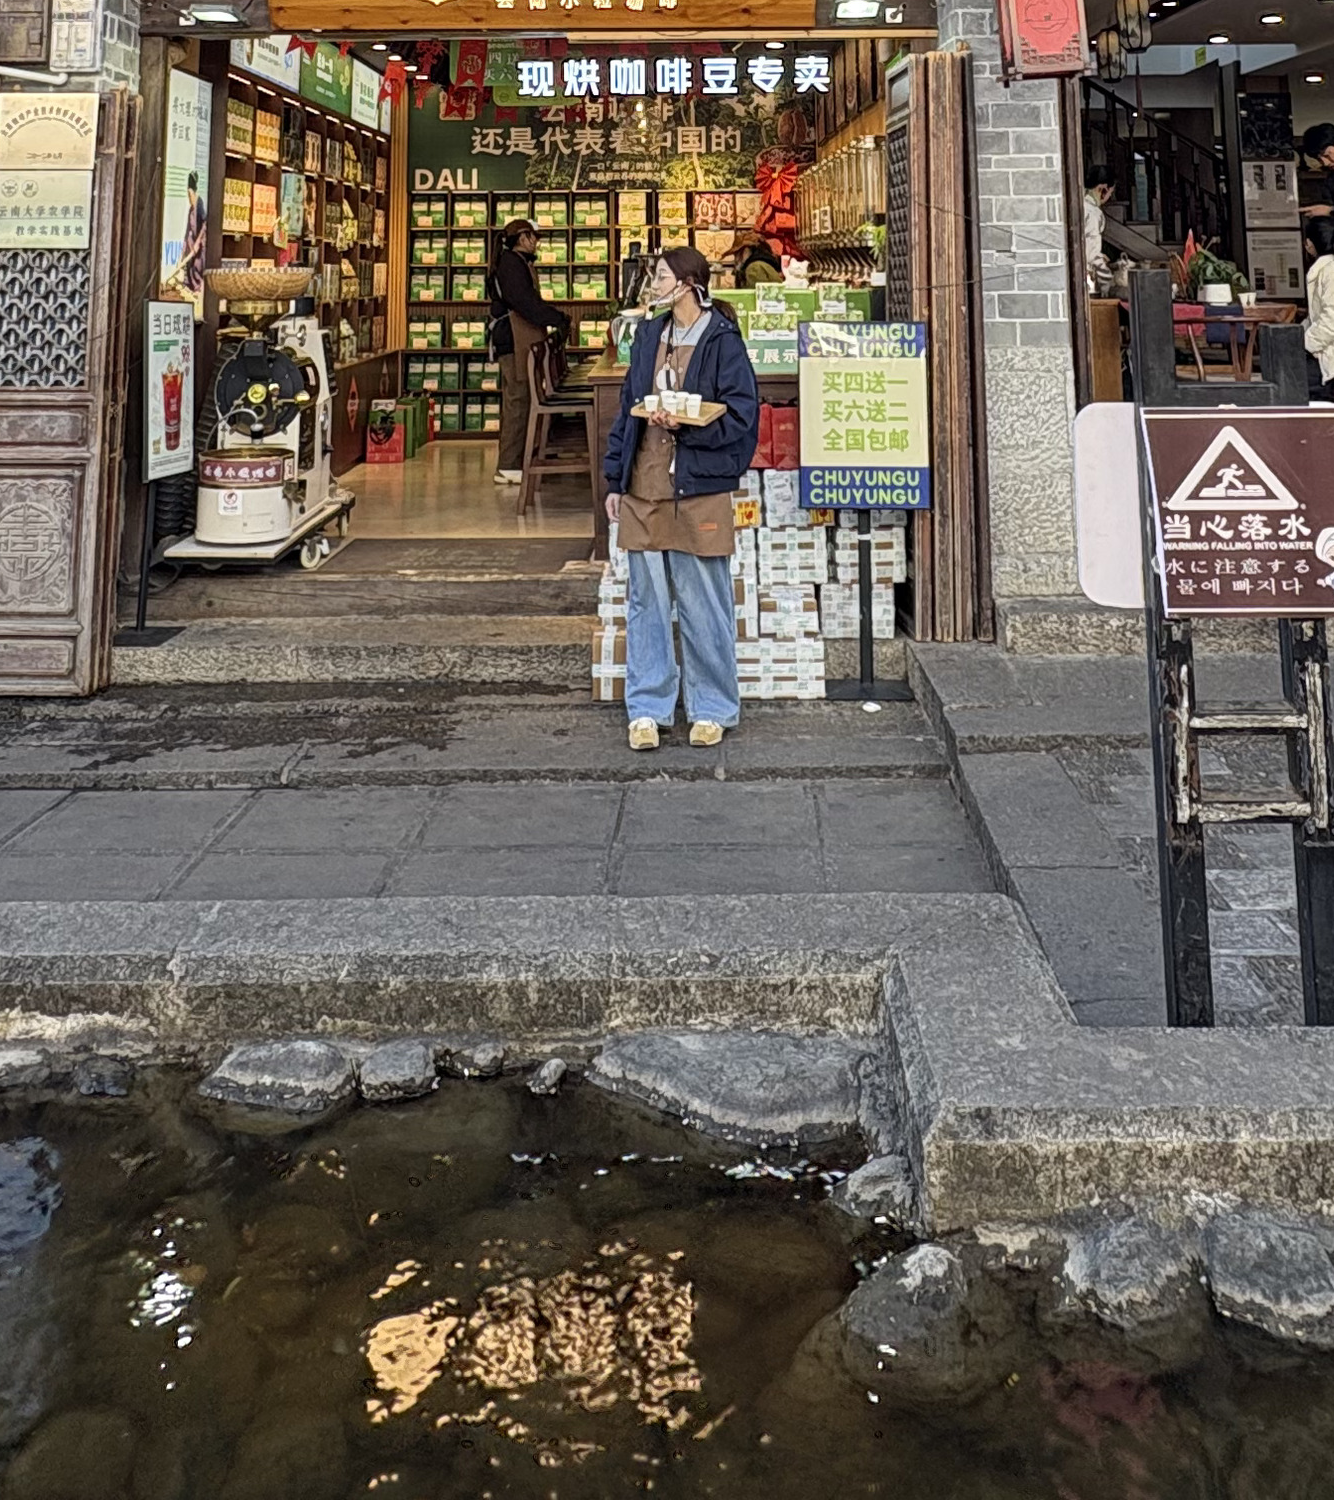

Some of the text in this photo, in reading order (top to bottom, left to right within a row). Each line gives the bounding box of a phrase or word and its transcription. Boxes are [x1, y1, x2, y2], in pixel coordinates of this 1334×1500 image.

[516, 55, 832, 97] 现烘咖啡豆专卖
[414, 169, 478, 191] DALI
[822, 371, 909, 394] 买四送一
[822, 399, 909, 423] 买六送二
[822, 429, 909, 452] 全国包邮
[810, 470, 920, 486] CHUYUNGU
[810, 488, 920, 505] CHUYUNGU
[1163, 513, 1312, 540] 当心落水
[1163, 541, 1314, 551] WARNING FALLING INTO WATER
[1166, 557, 1311, 575] 水に注意する
[1232, 577, 1304, 596] 빠지다
